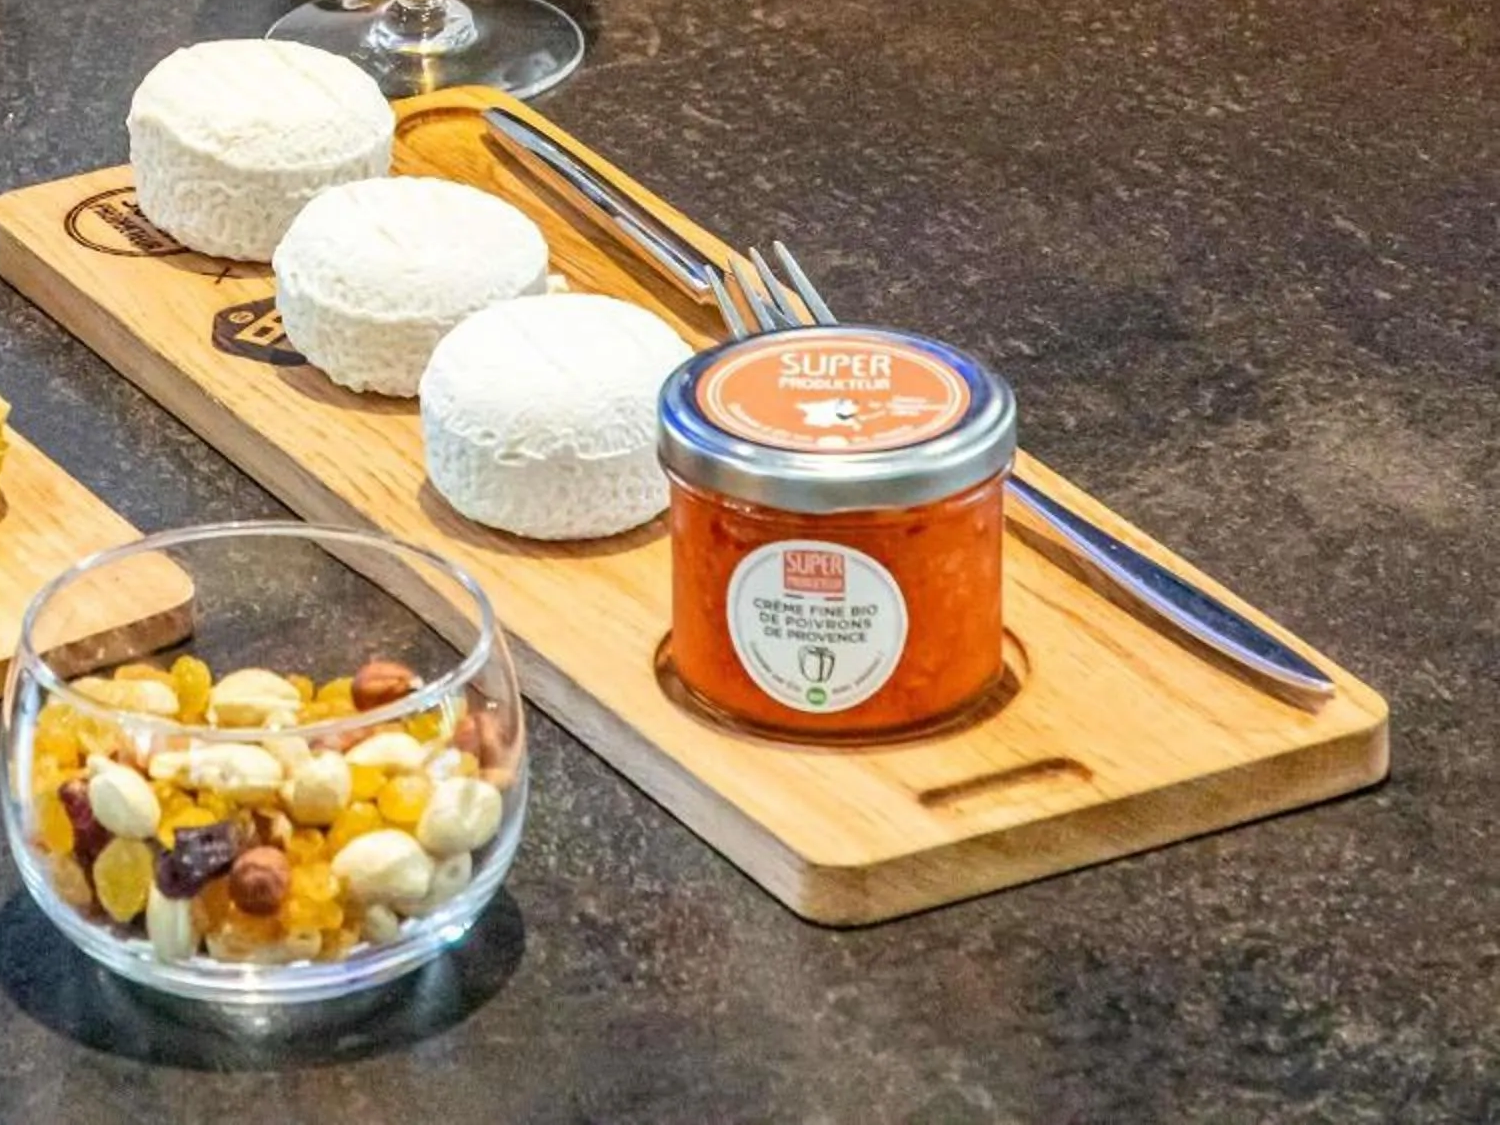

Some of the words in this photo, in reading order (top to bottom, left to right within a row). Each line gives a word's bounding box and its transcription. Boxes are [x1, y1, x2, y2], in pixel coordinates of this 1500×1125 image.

[779, 352, 892, 378] SUPER
[785, 552, 844, 576] SUPER
[810, 604, 845, 617] FINE
[851, 604, 879, 617] BIO
[759, 612, 779, 624] DE
[785, 616, 872, 630] POIVRONS
[764, 626, 782, 639] DE
[787, 629, 868, 644] PROVENCE
